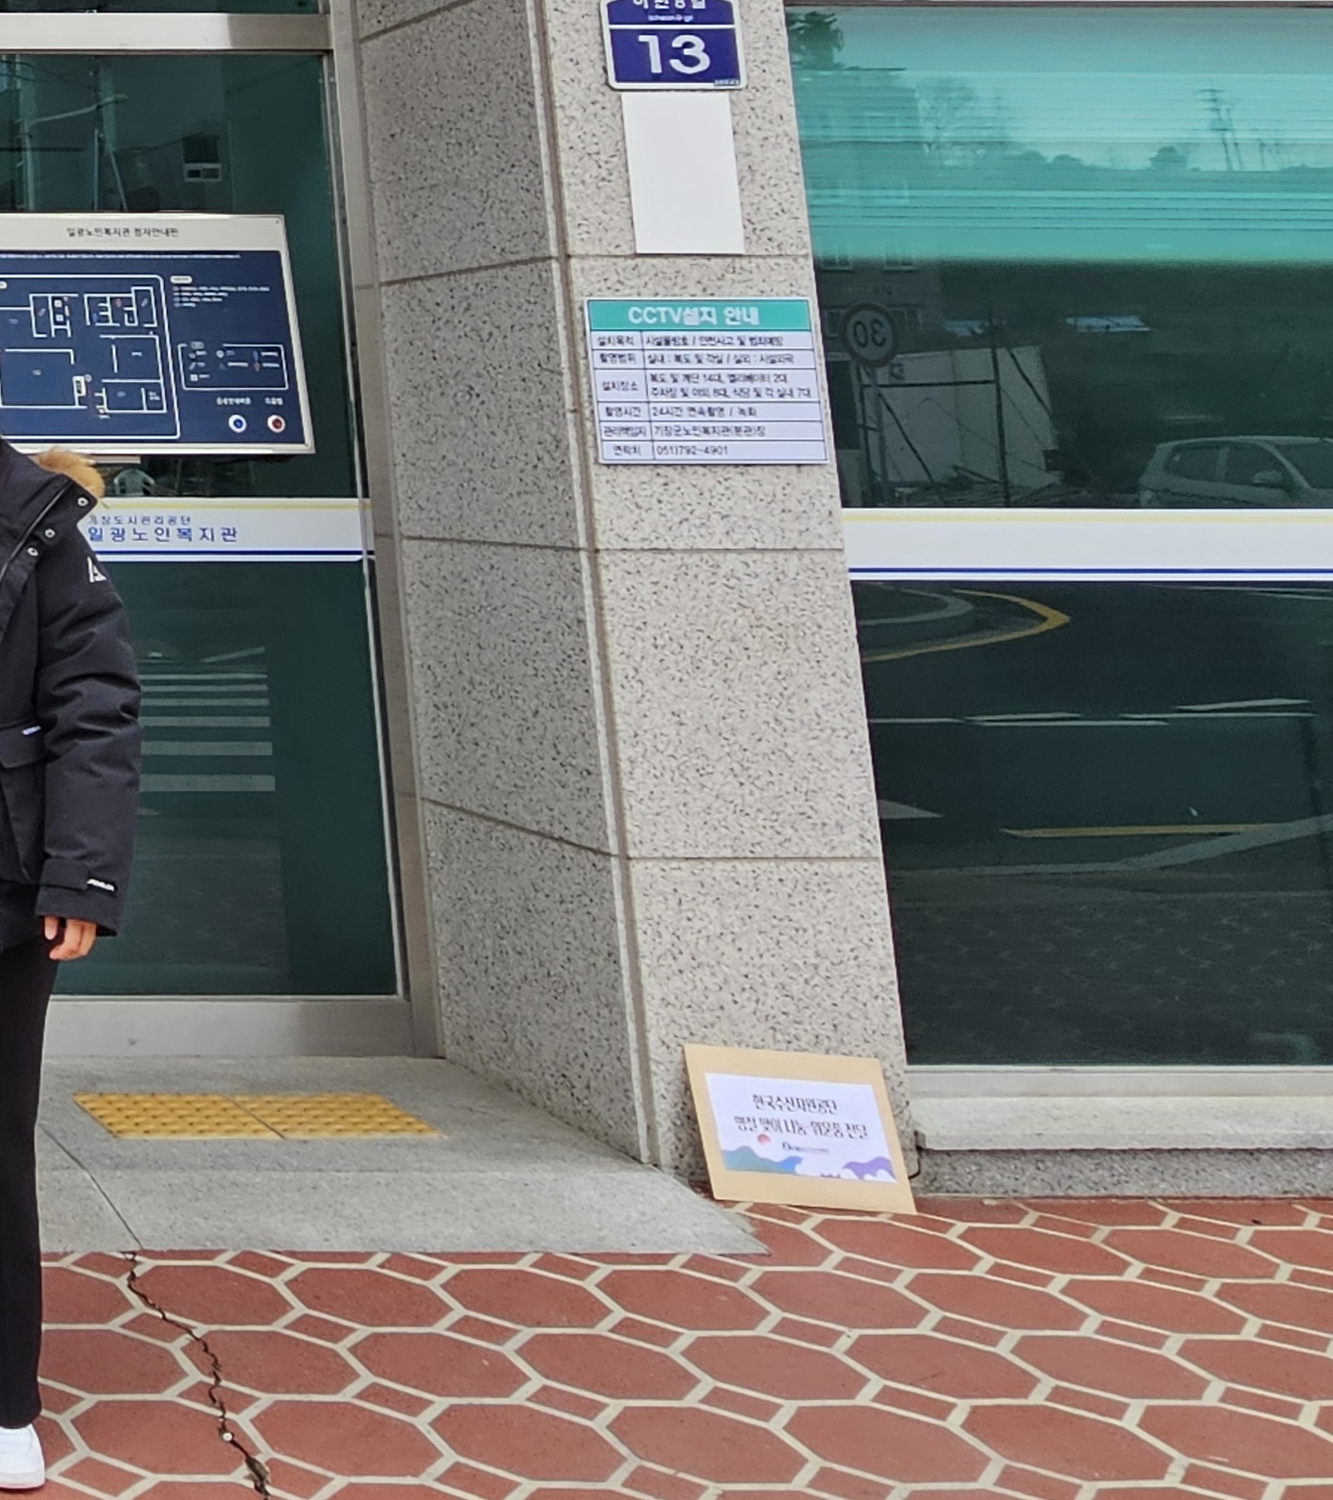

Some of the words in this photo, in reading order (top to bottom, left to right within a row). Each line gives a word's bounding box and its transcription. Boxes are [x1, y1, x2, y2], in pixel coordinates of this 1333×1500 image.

[638, 34, 711, 75] 13
[723, 306, 760, 326] 안내
[88, 526, 237, 542] 일광노인복지관
